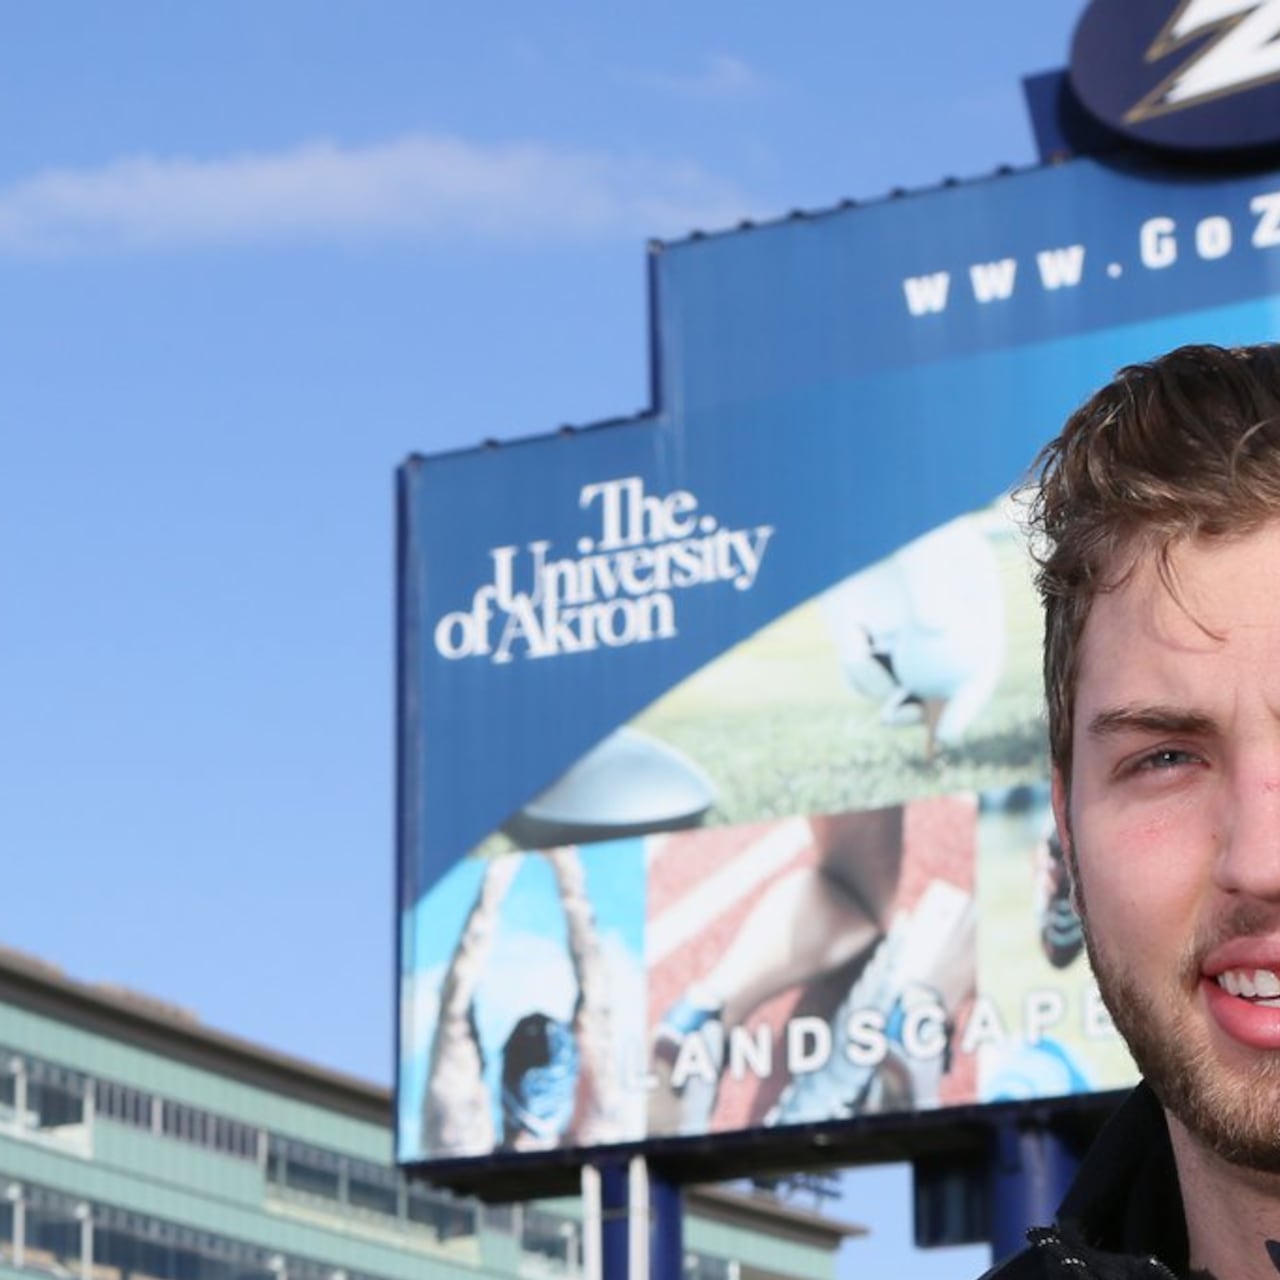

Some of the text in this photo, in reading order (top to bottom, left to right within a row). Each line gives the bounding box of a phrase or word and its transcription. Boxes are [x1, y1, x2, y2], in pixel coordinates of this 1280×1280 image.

[488, 525, 775, 613] University
[434, 584, 678, 664] of Akron
